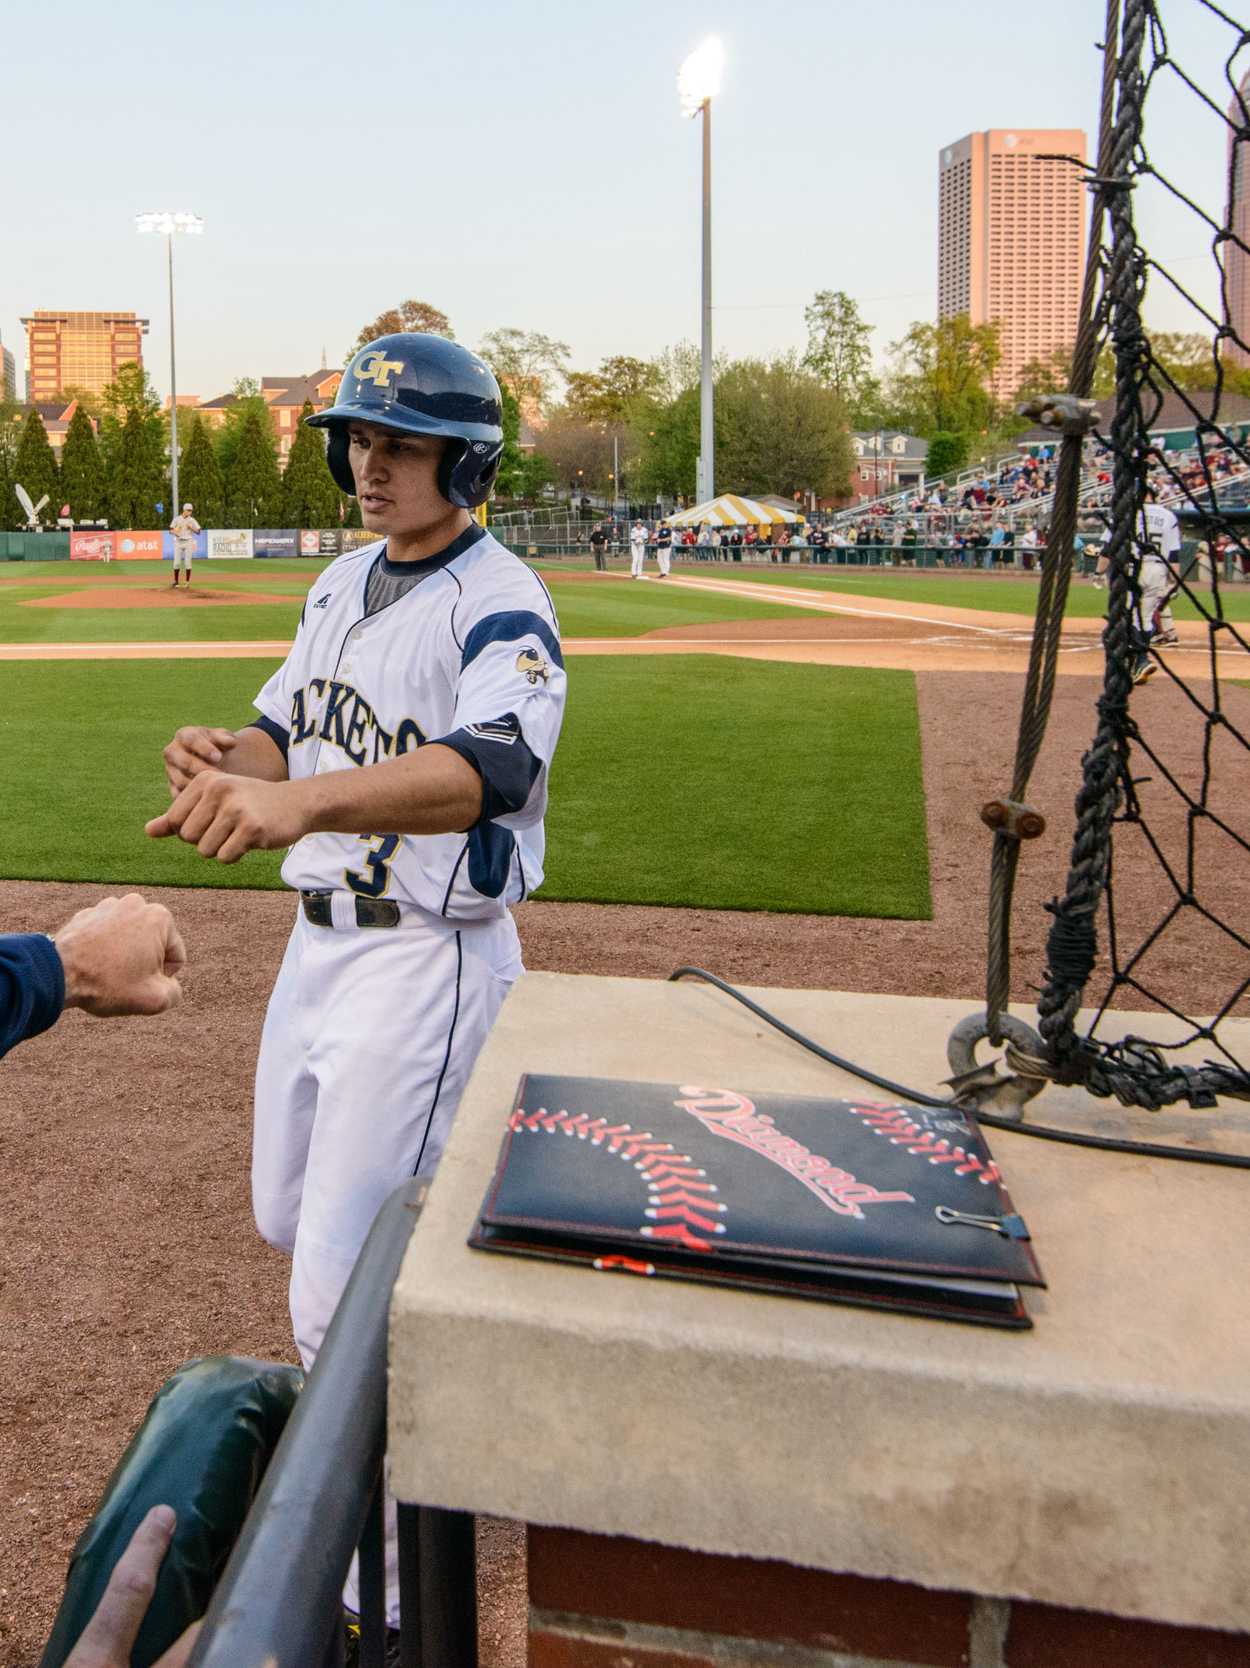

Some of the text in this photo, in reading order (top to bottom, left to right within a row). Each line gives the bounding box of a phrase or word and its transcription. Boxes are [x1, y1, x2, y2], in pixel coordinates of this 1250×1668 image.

[353, 351, 404, 388] GT
[137, 541, 158, 551] at&t
[290, 677, 428, 767] ACKETS
[674, 1084, 916, 1219] Diamond
